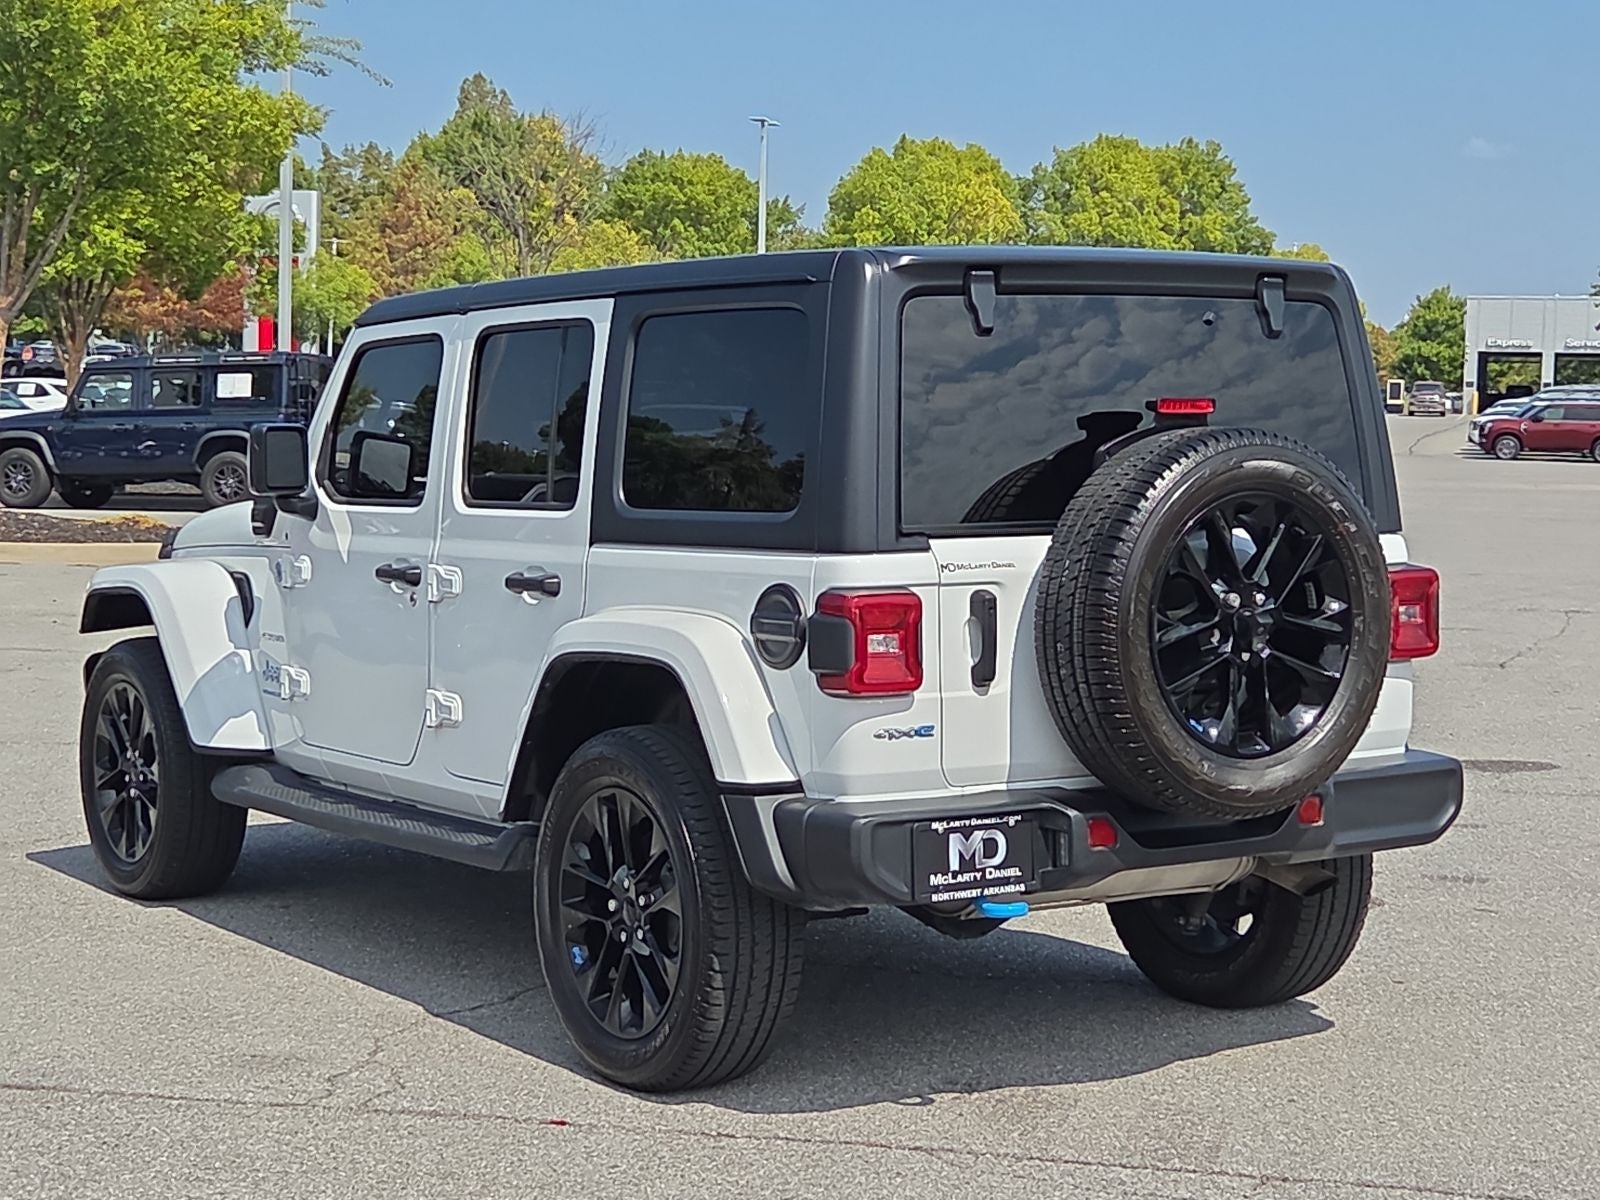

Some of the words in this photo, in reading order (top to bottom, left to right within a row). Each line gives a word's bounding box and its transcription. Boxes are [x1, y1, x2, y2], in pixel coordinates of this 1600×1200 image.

[1487, 337, 1533, 348] Express
[948, 829, 1007, 871] MD
[985, 867, 1022, 879] DANIEL
[932, 889, 982, 901] NORTHWEST
[983, 883, 1025, 896] ARKANSAS
